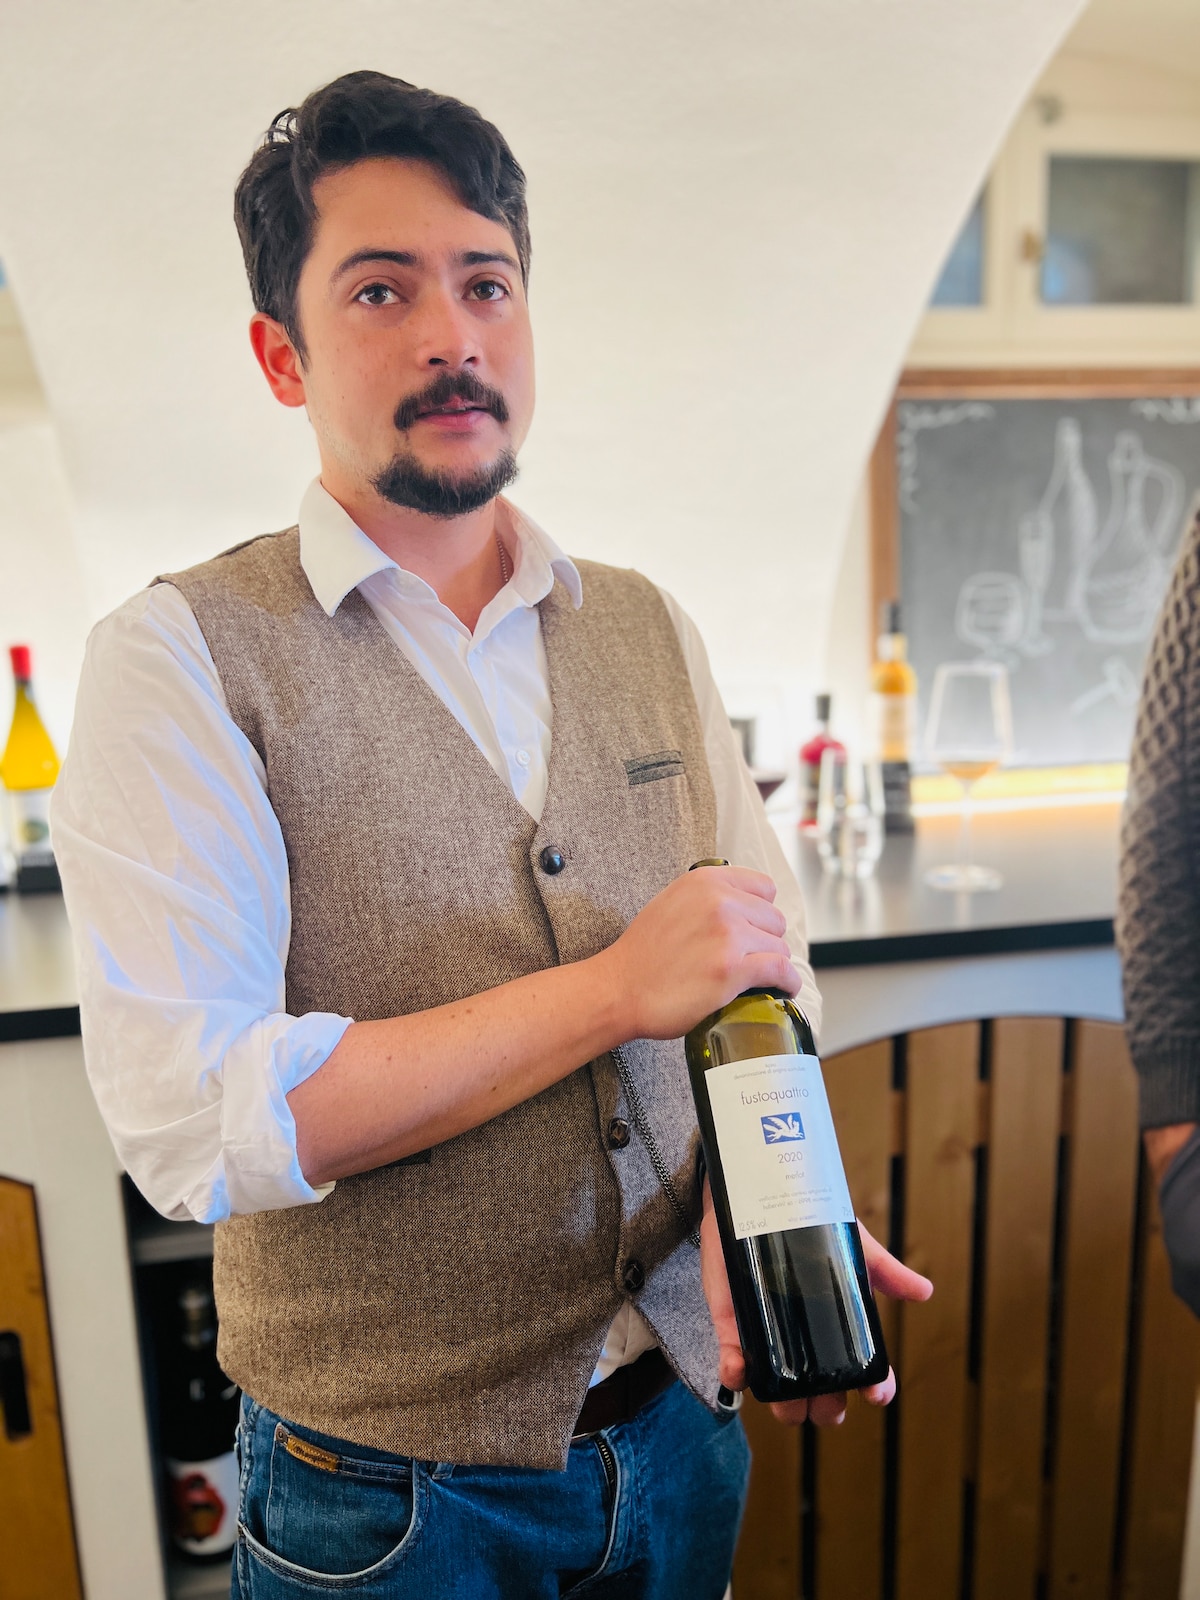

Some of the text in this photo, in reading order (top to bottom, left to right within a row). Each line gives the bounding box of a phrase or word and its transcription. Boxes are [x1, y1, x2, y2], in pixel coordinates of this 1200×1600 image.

[741, 1087, 809, 1105] fustoquattro
[777, 1151, 803, 1164] 2020
[785, 1171, 805, 1180] merlot
